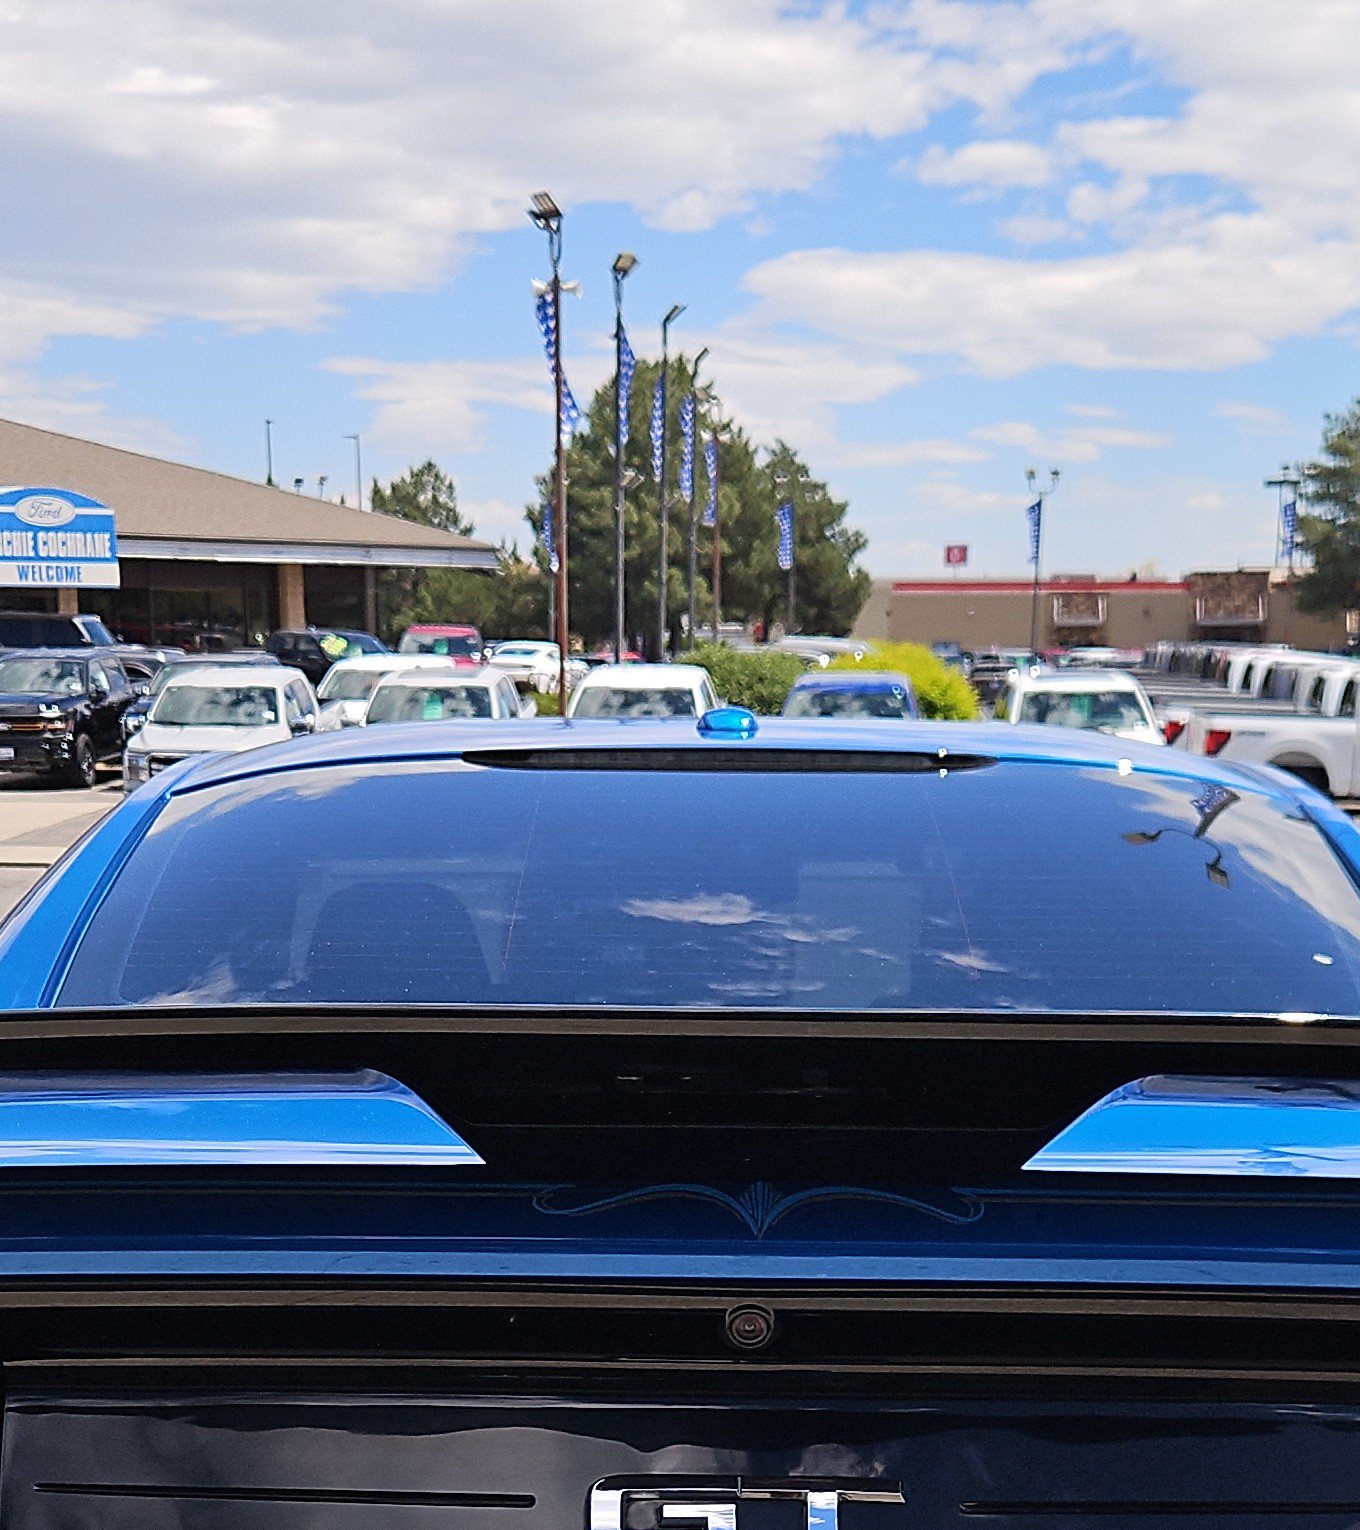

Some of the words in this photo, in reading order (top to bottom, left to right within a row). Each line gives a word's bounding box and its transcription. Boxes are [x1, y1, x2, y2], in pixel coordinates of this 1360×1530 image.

[27, 501, 63, 519] Ford
[36, 530, 112, 558] COCHRANE
[17, 564, 83, 583] WELCOME
